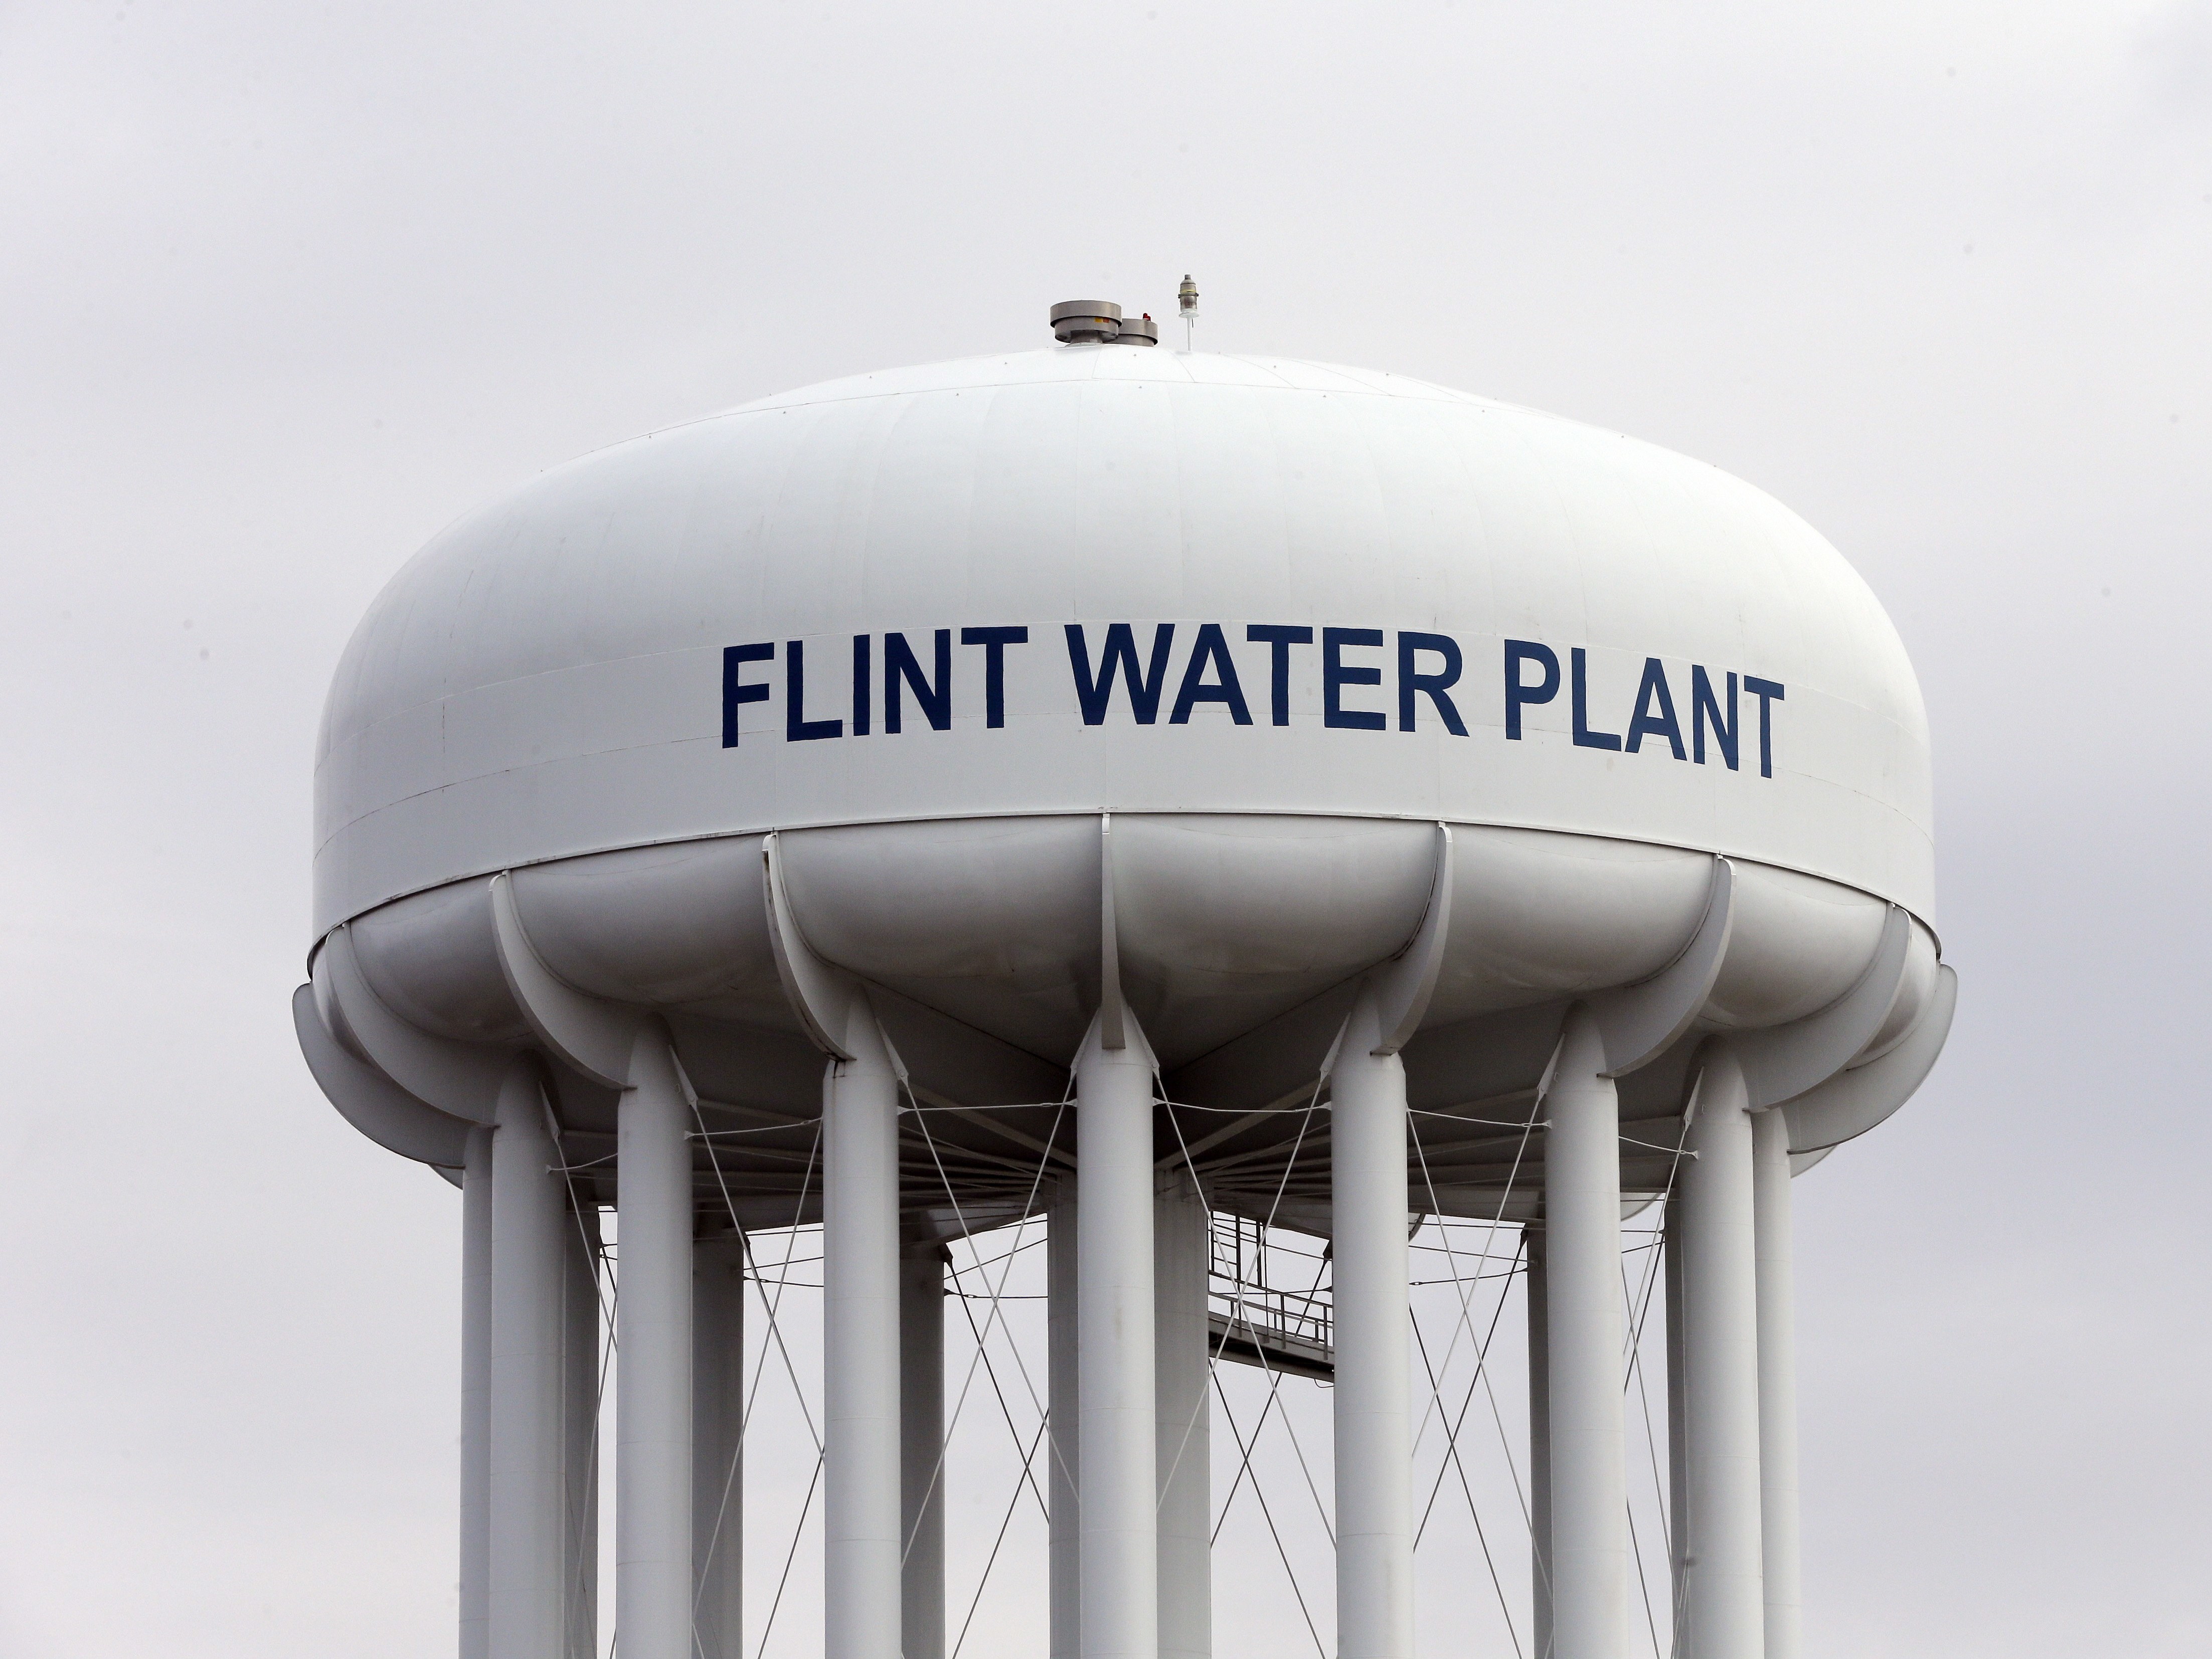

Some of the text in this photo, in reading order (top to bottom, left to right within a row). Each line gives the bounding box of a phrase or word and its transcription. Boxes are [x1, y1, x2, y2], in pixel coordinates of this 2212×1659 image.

[722, 623, 1785, 778] FLINT WATER PLANT
